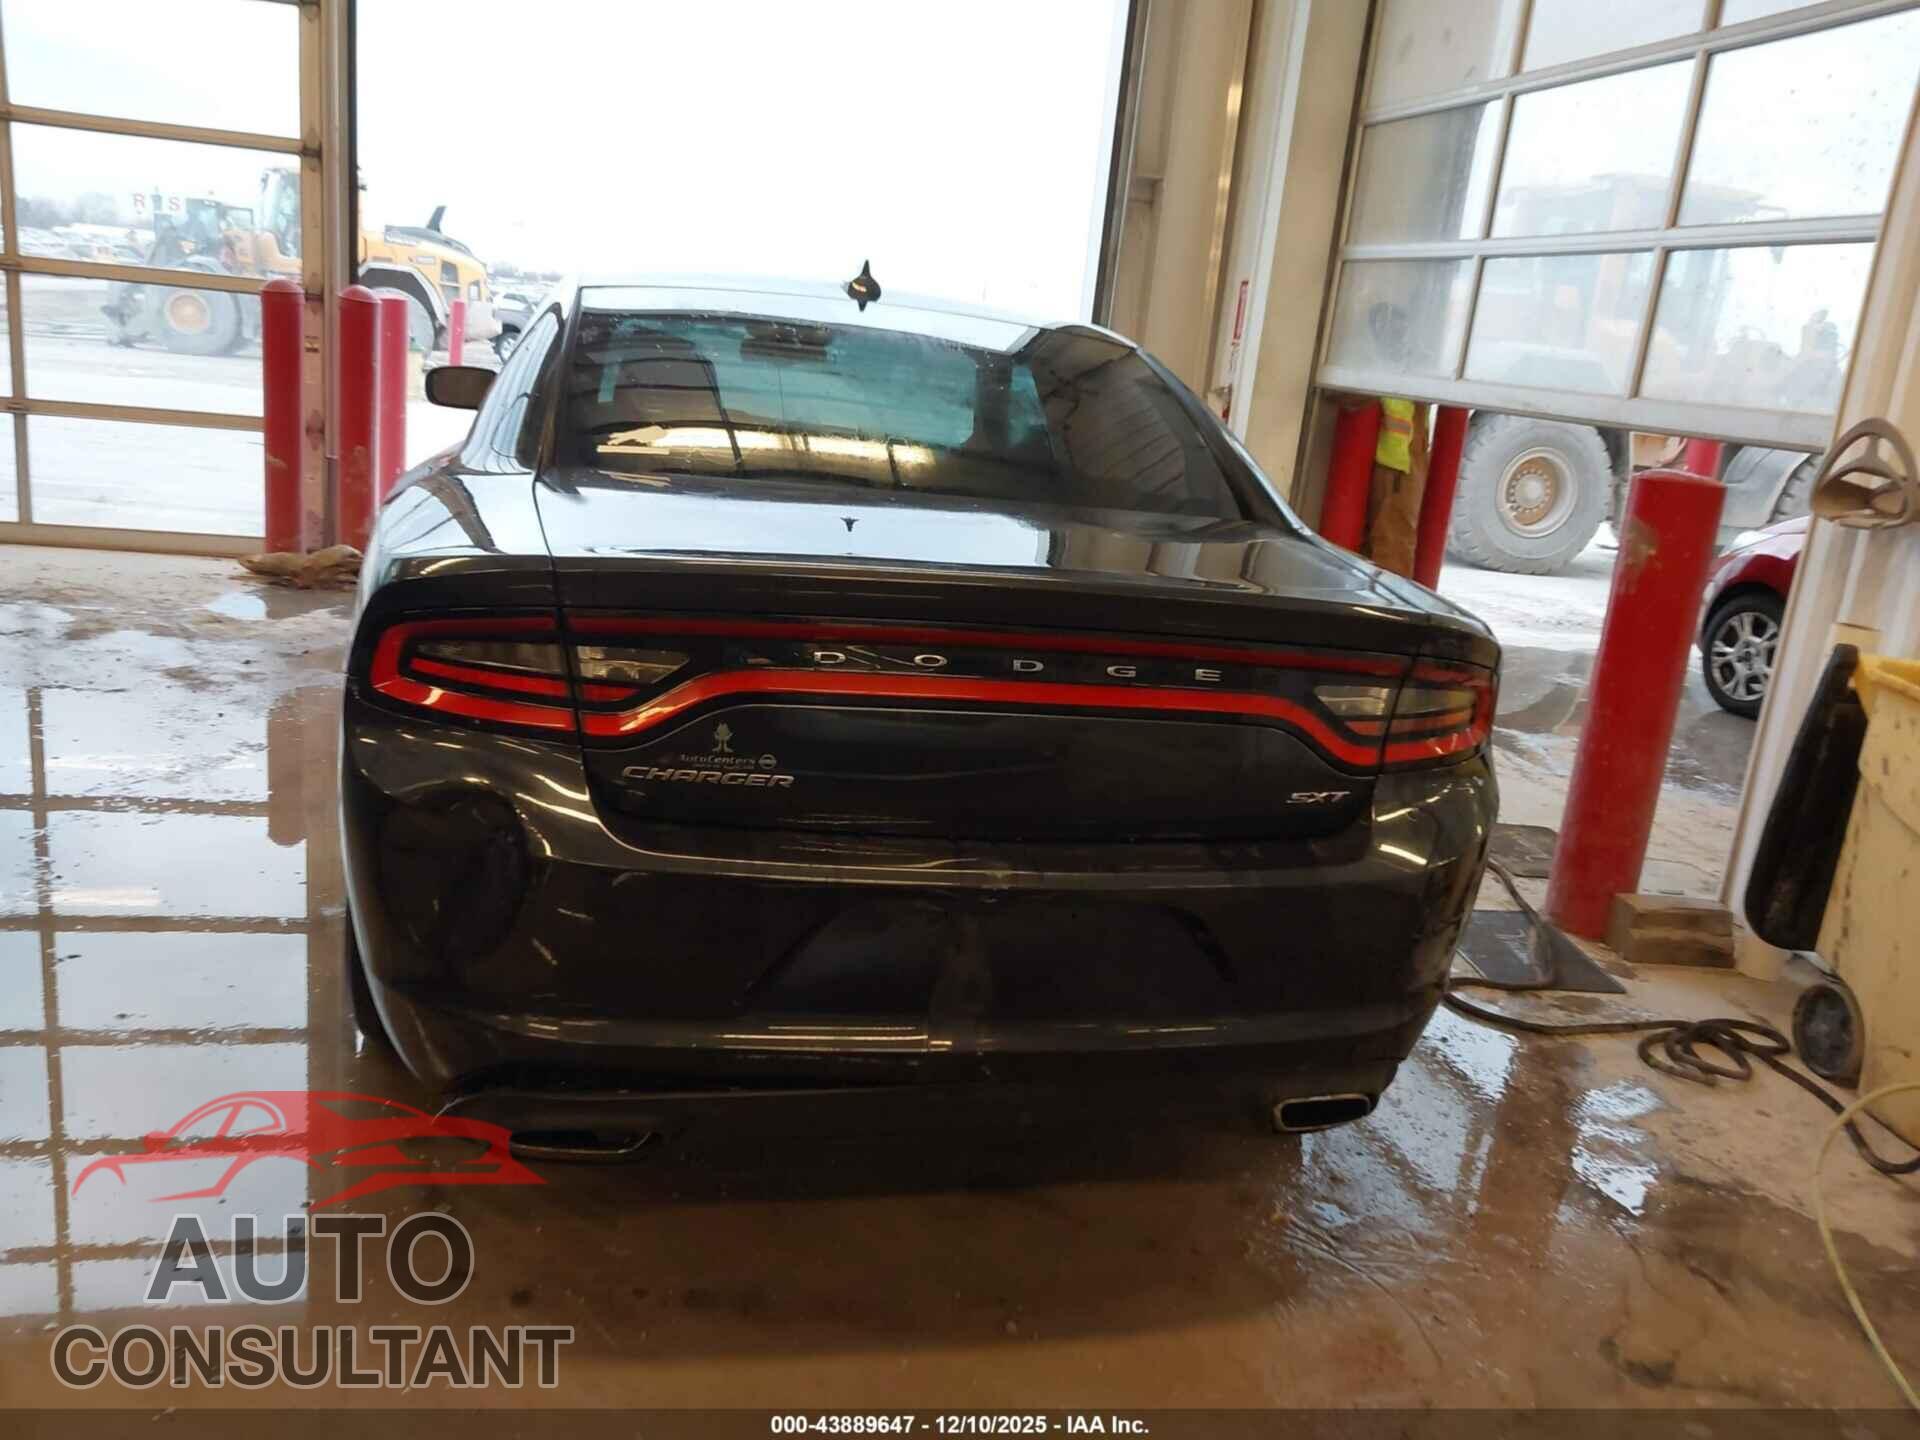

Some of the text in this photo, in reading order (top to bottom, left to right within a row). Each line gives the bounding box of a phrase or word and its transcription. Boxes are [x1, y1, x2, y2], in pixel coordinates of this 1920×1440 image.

[813, 651, 1223, 682] DODGE
[621, 765, 796, 788] CHARGER
[1284, 790, 1351, 805] SXT
